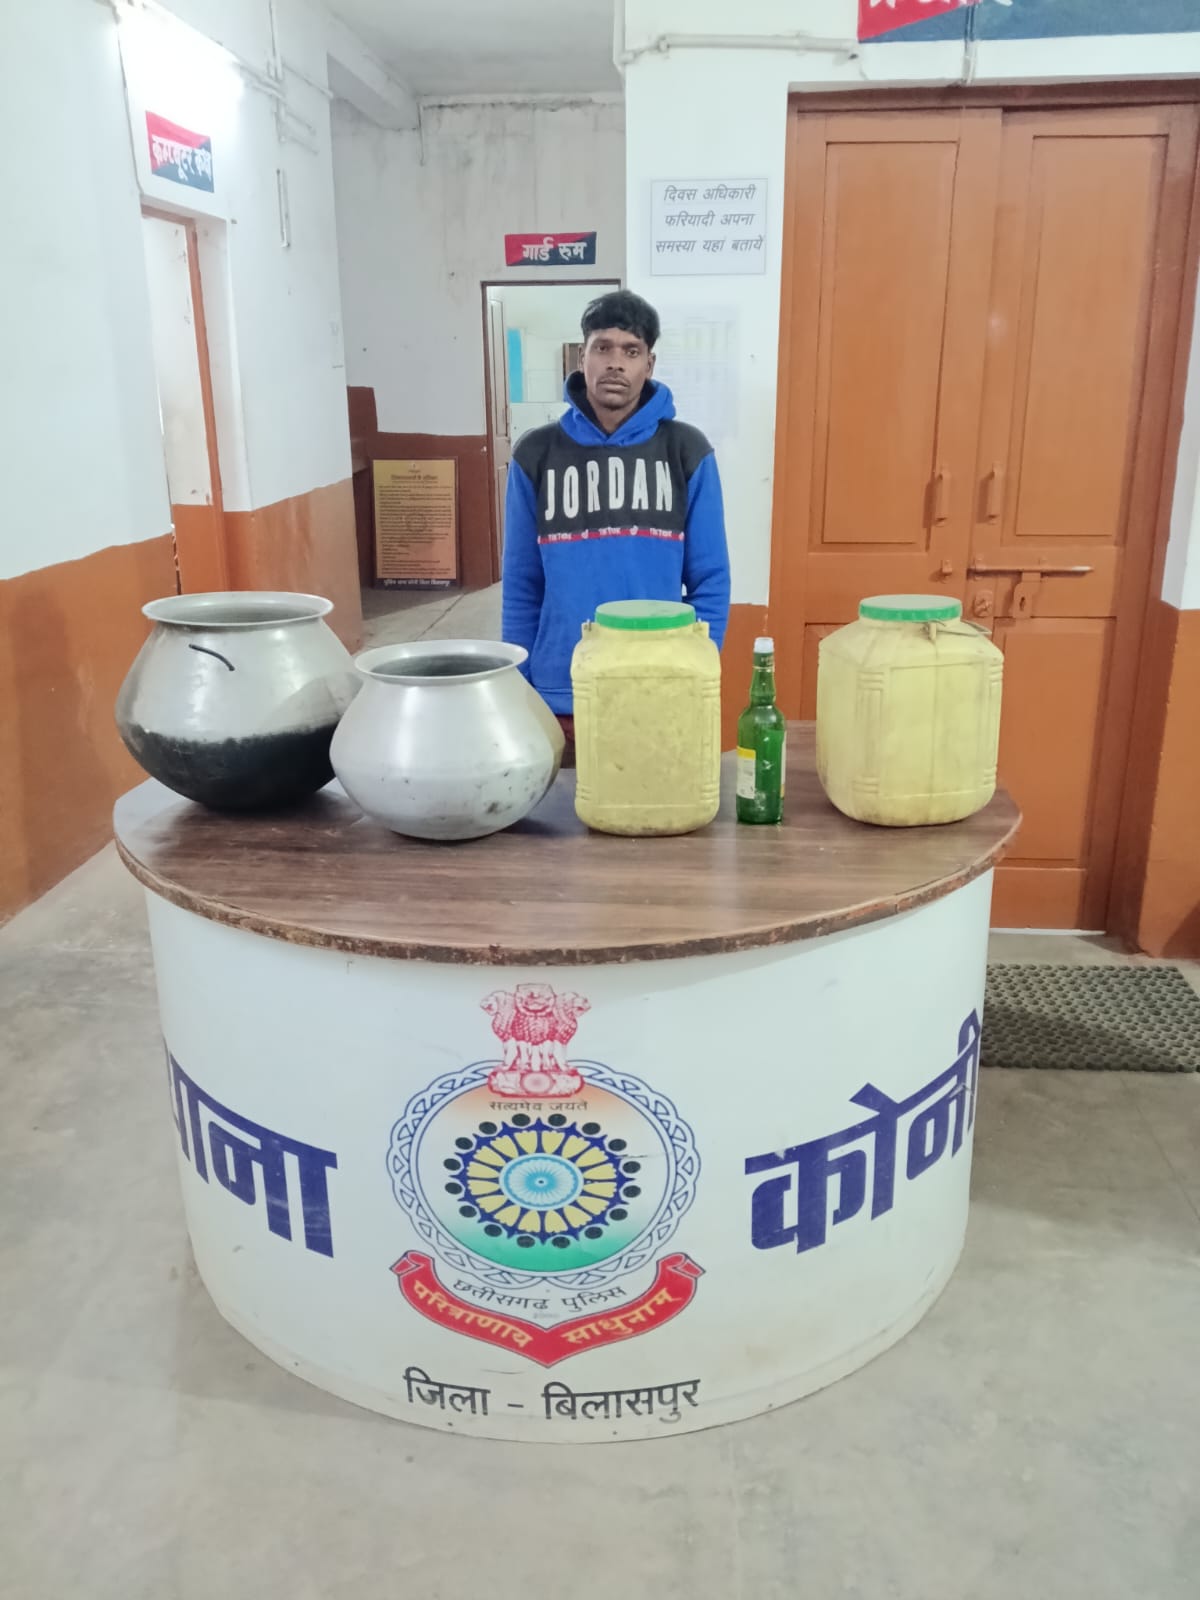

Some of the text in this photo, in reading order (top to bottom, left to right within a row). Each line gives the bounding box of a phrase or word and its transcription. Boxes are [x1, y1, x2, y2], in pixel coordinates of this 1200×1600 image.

[663, 183, 756, 201] दिवस अधिकारी
[665, 210, 755, 226] फरियादी अपना
[521, 236, 555, 261] गार्ड
[656, 240, 698, 252] समस्या
[545, 456, 673, 521] JORDAN
[489, 1099, 588, 1112] सत्यमेव जयते
[560, 1286, 627, 1313] पुलिस
[402, 1366, 491, 1416] जिला
[541, 1379, 702, 1424] बिलासपुर
